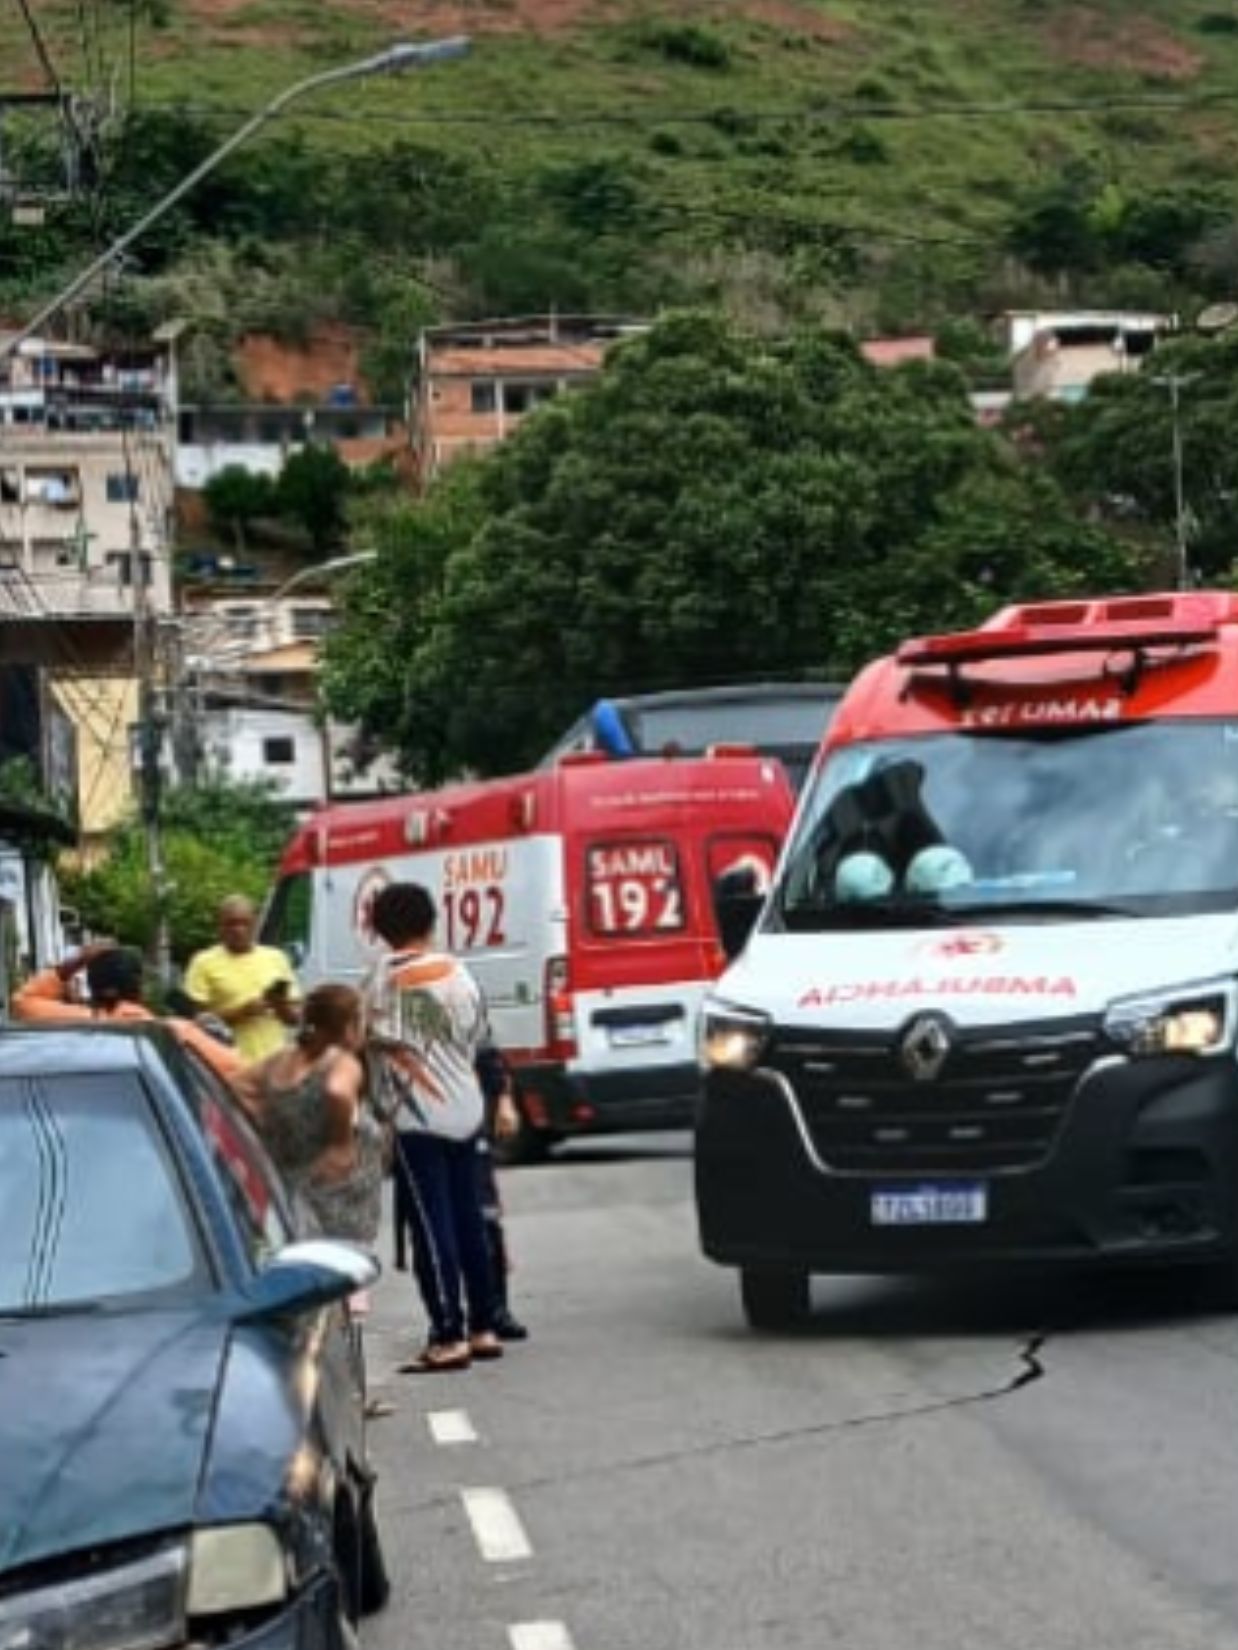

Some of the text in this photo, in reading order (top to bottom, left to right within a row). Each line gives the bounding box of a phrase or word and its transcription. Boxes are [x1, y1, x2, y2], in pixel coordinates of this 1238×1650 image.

[443, 849, 508, 886] SAMU
[441, 884, 506, 949] 192
[592, 879, 682, 931] 192
